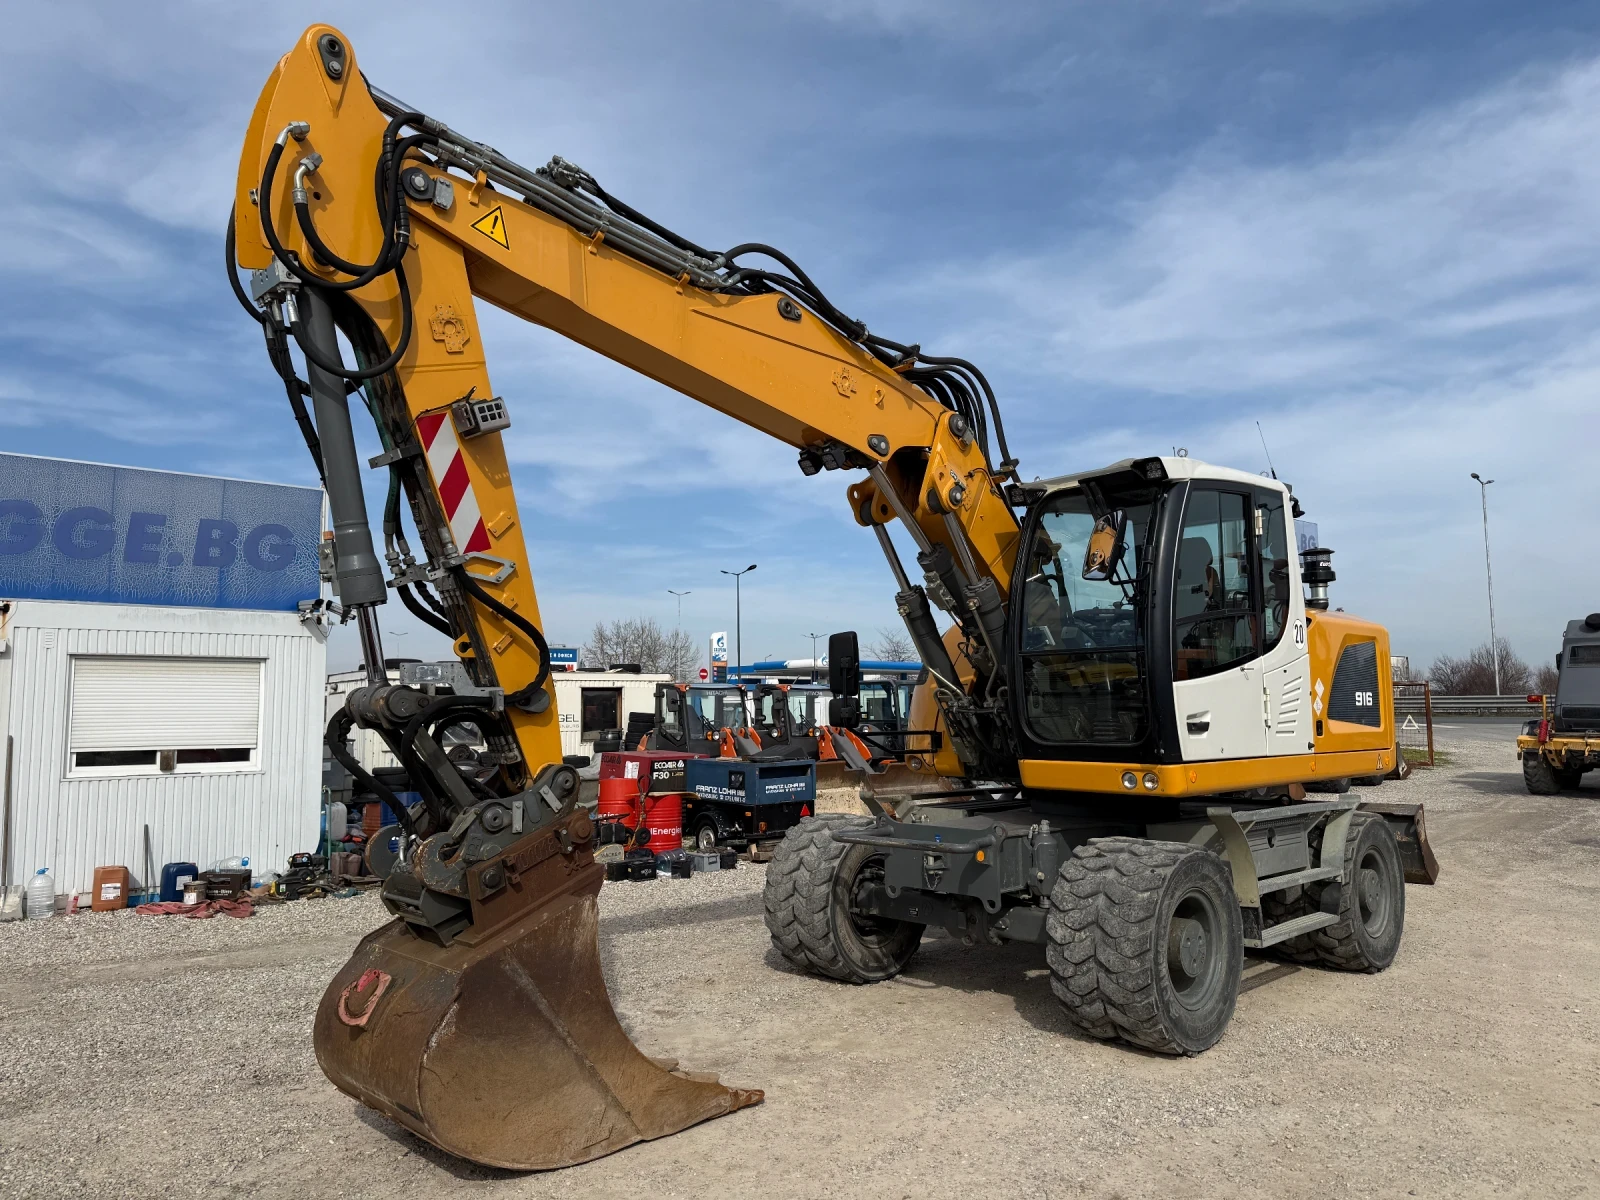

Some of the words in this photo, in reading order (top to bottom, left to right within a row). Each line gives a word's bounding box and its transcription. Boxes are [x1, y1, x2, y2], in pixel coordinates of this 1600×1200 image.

[1294, 624, 1304, 643] 20
[1354, 691, 1373, 706] 916
[654, 761, 677, 769] ECOAIR
[653, 771, 670, 780] F30
[695, 784, 718, 794] FRANZ
[718, 786, 737, 796] LOHR
